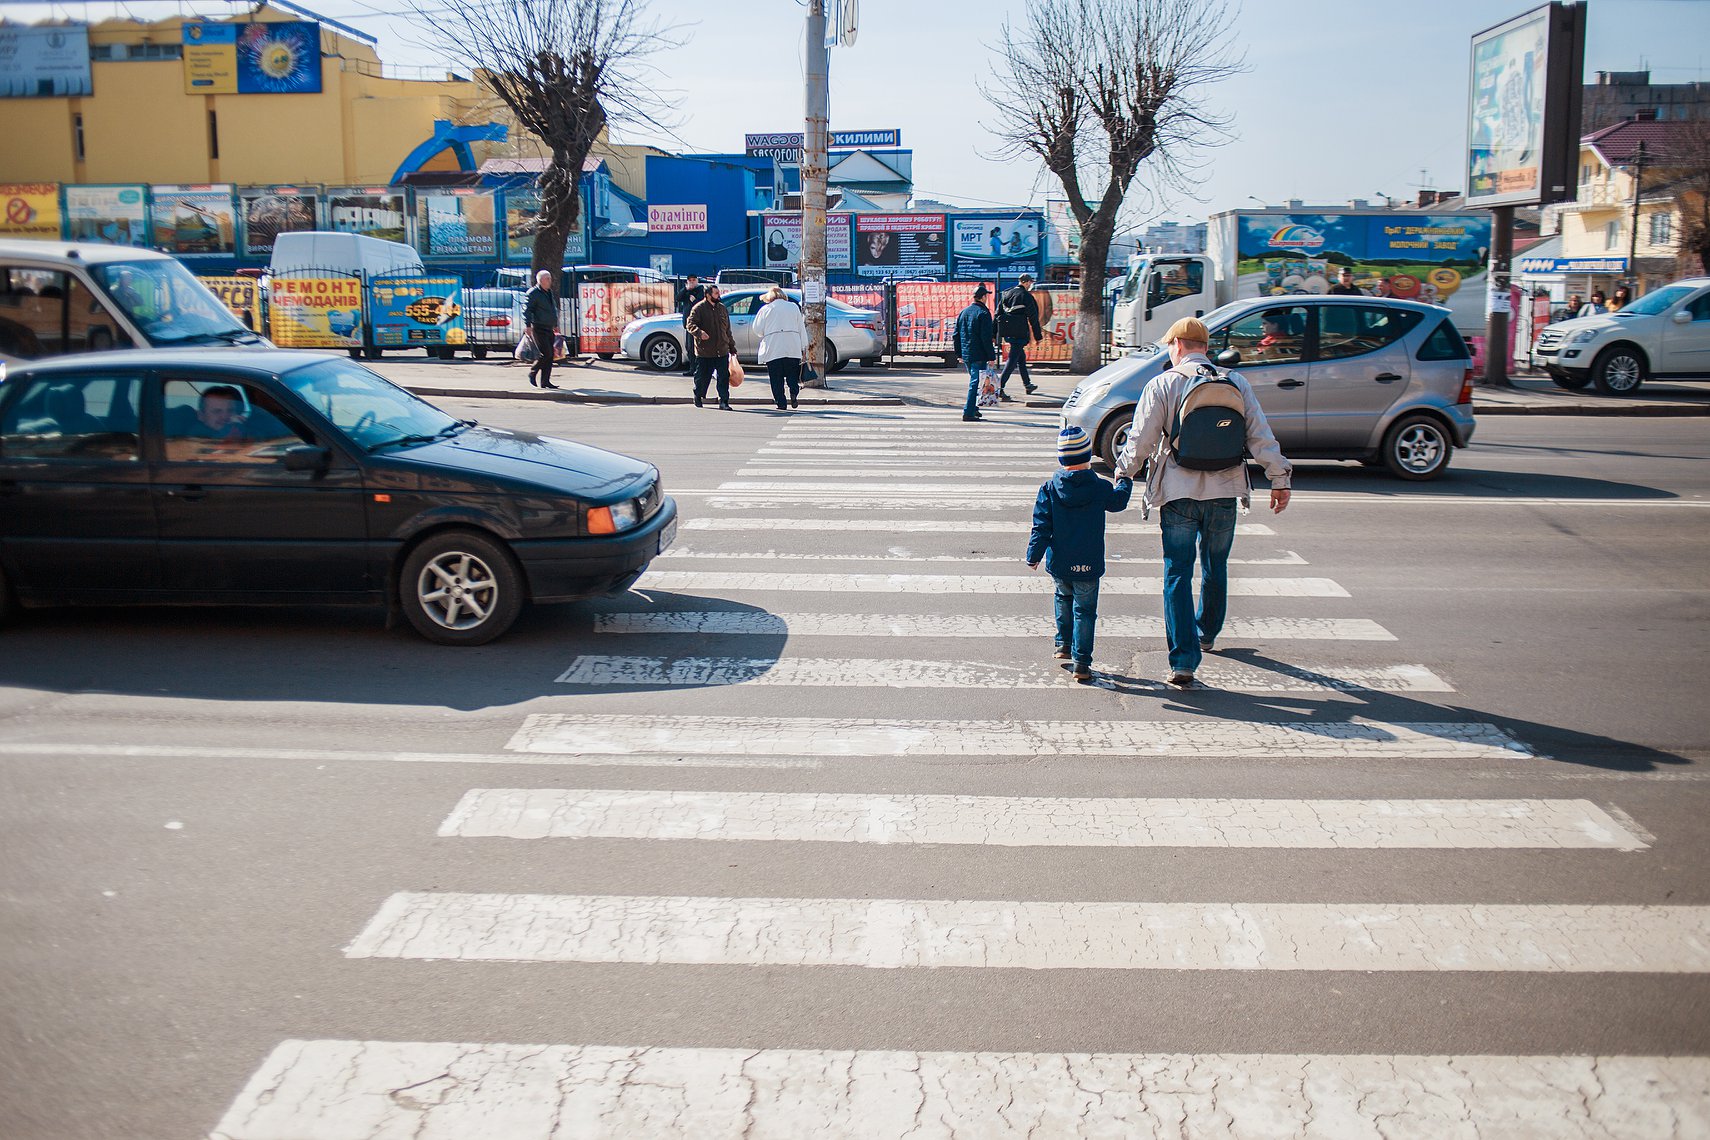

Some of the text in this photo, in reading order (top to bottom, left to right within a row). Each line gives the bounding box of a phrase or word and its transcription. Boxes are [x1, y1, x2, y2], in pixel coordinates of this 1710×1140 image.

[836, 133, 894, 144] КИЛИМИ
[650, 208, 706, 222] Фламінго
[666, 223, 682, 231] ДЛЯ
[683, 222, 705, 231] ДІТЕЙ
[961, 233, 983, 242] МРТ
[273, 281, 357, 294] РЕМОНТ
[897, 285, 929, 294] СКЛАД
[273, 295, 358, 308] ЧЕМОДАНІВ
[847, 296, 864, 305] 250
[585, 303, 611, 323] 45
